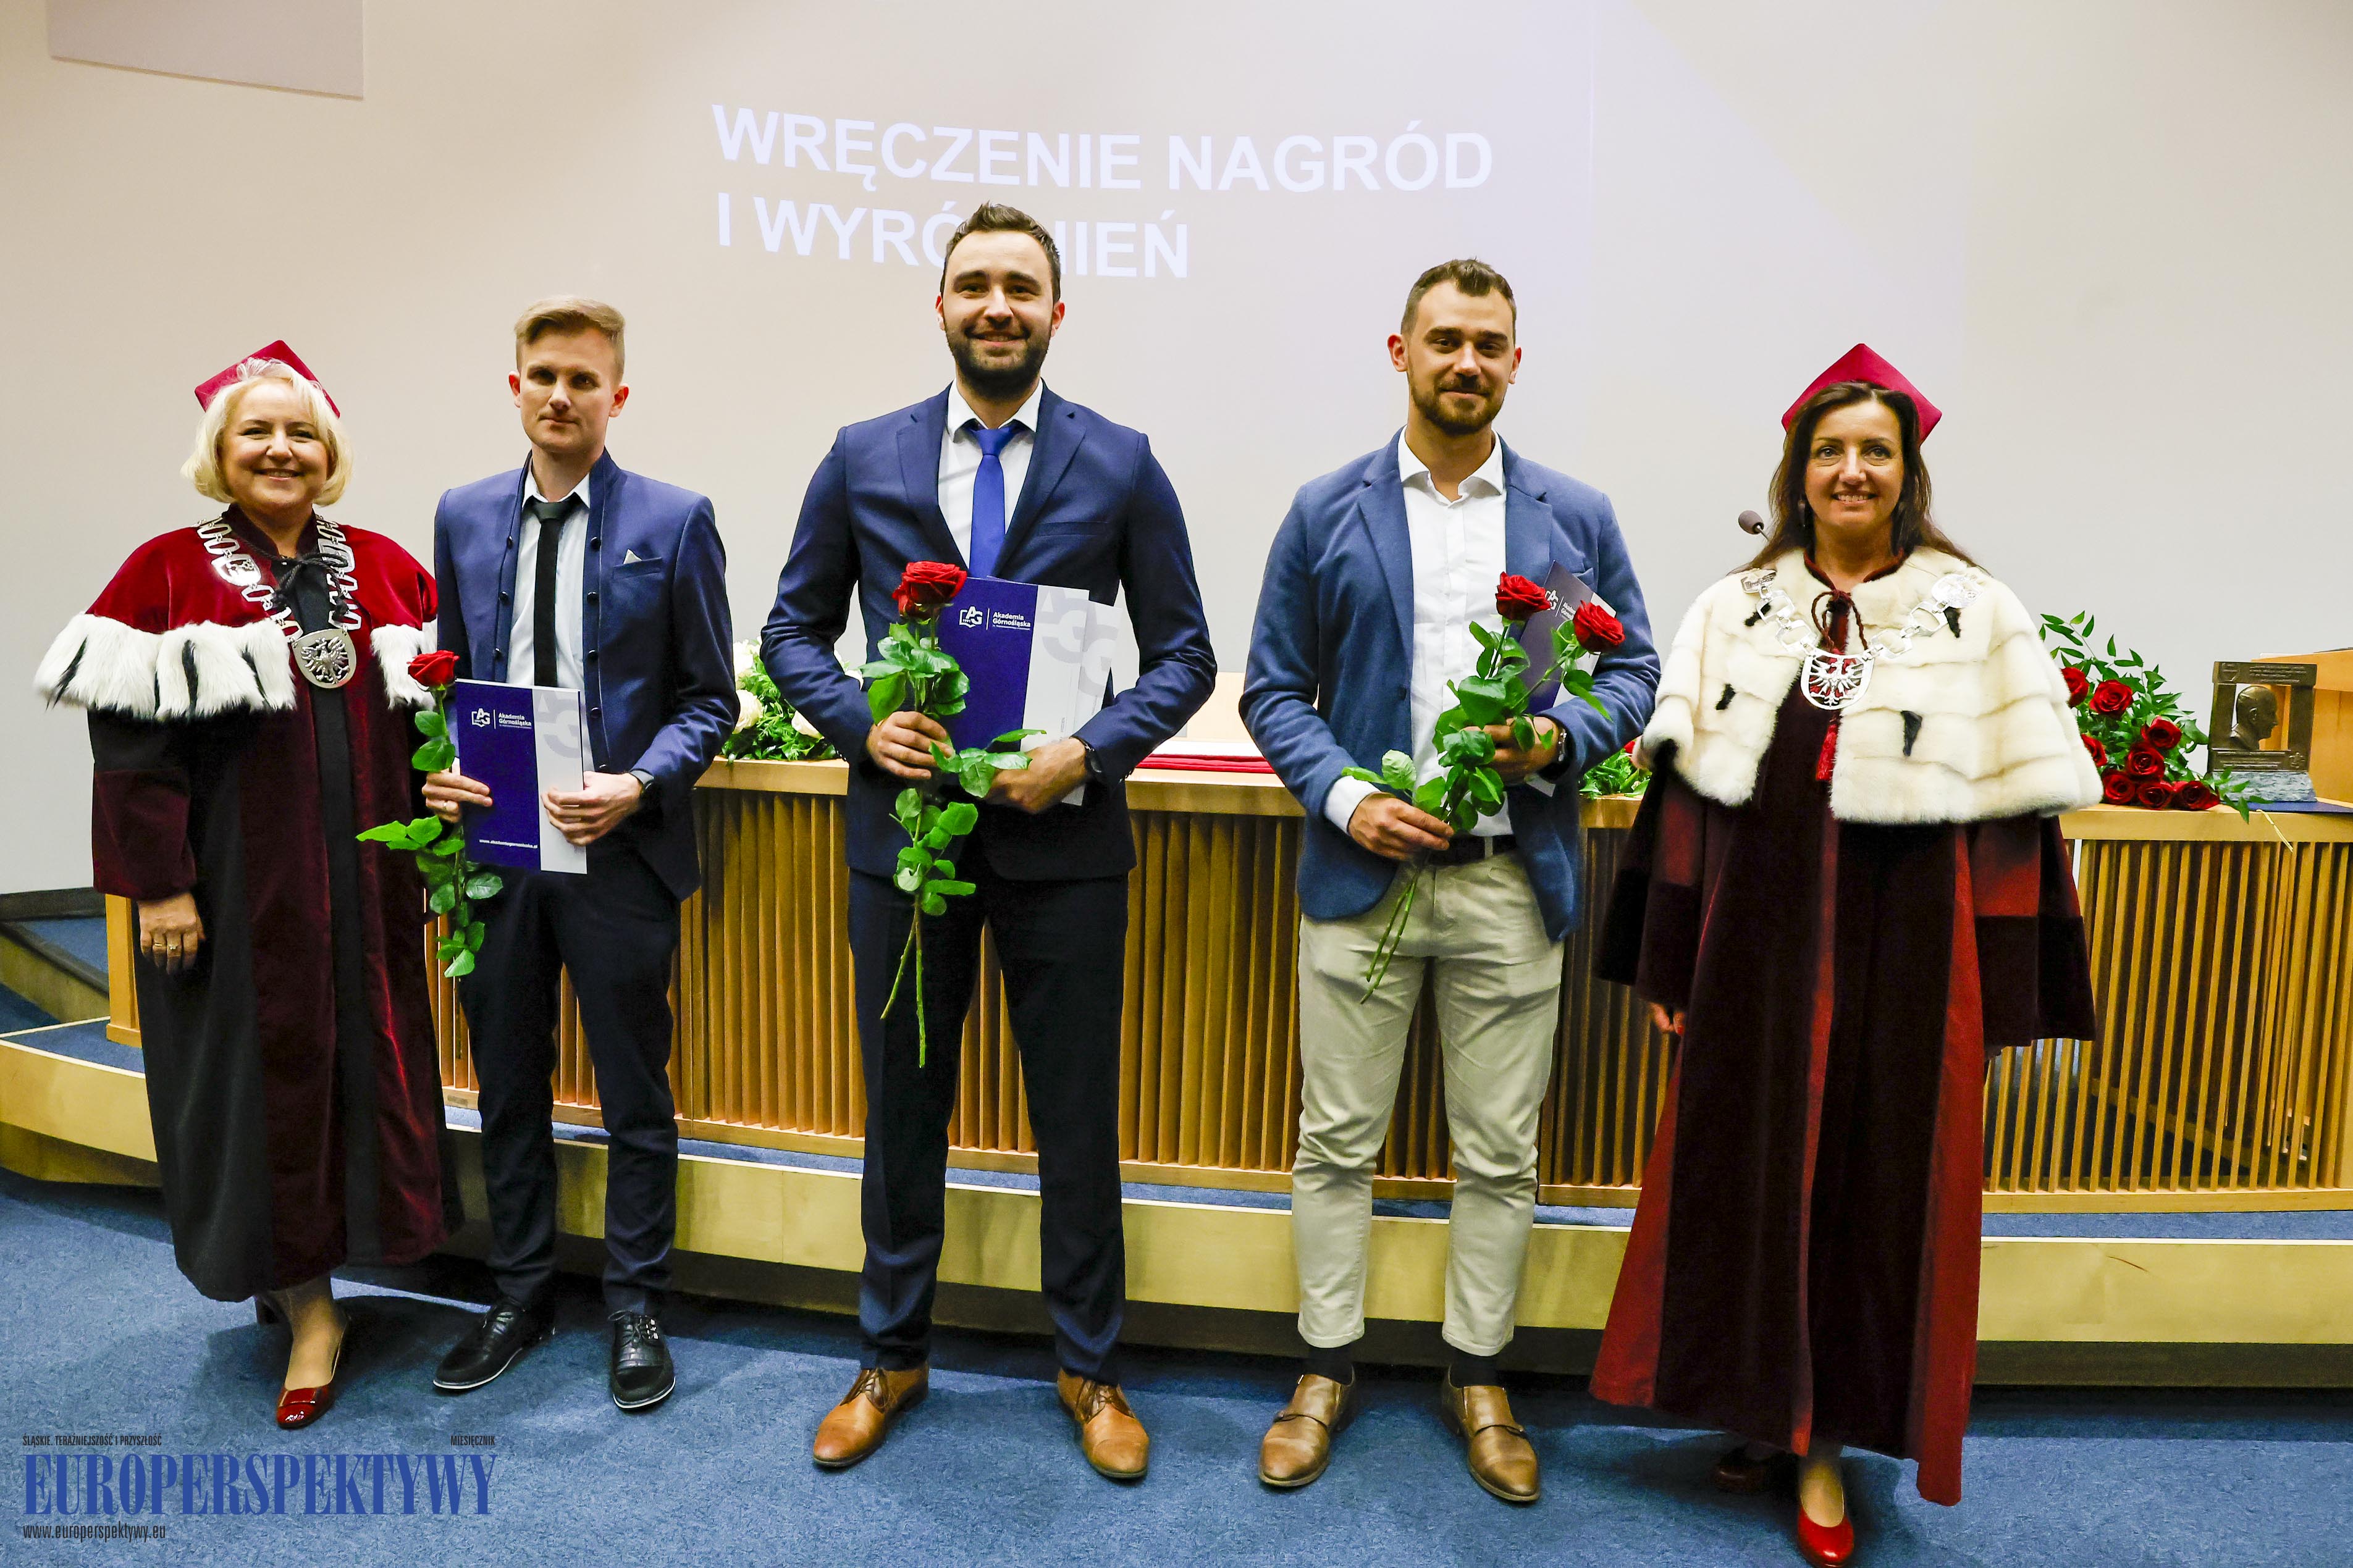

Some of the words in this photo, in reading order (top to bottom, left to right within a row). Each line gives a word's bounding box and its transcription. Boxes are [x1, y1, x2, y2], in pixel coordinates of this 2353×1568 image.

[712, 104, 1141, 191] WRĘCZENIE
[1169, 120, 1492, 192] NAGRÓD
[718, 192, 731, 246] I
[753, 196, 1189, 279] WYRÓIEŃ
[993, 611, 1024, 621] Akademia
[992, 618, 1031, 627] Górnośląska
[498, 712, 525, 721] Akademia
[499, 718, 532, 727] Górnośląska
